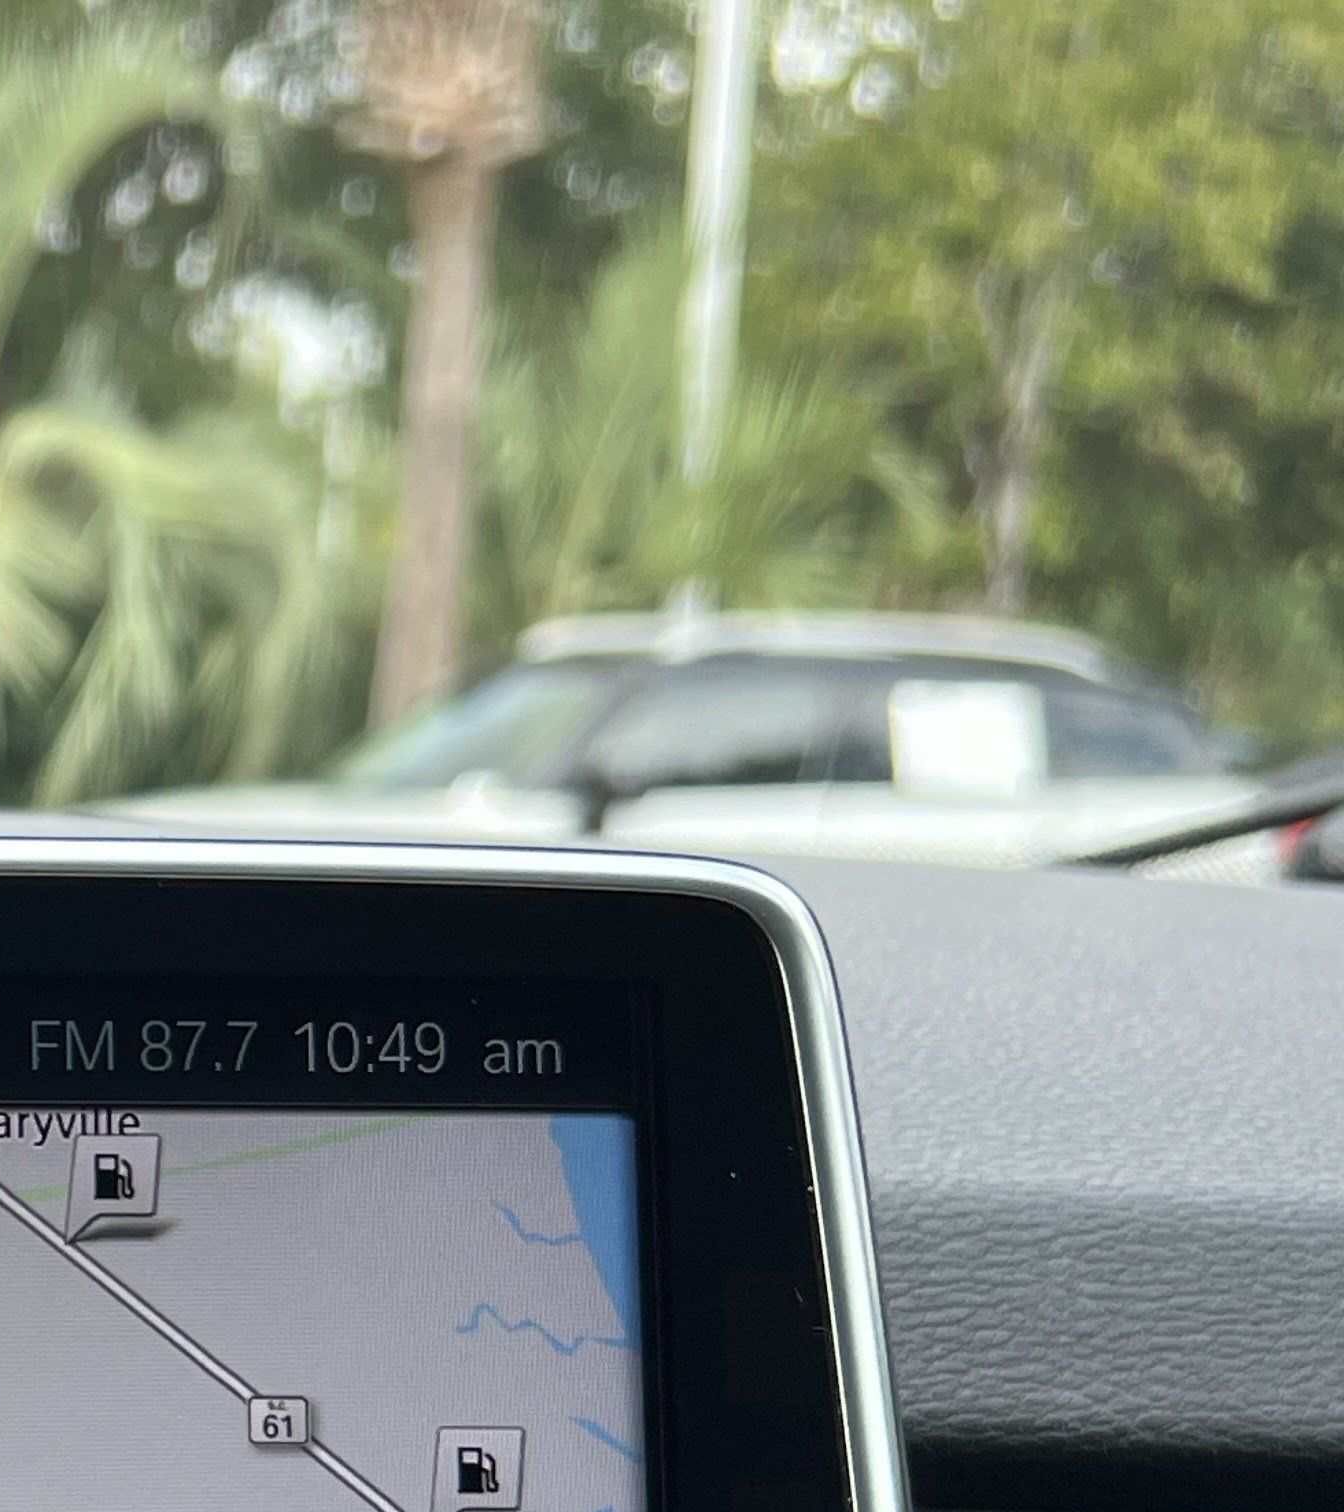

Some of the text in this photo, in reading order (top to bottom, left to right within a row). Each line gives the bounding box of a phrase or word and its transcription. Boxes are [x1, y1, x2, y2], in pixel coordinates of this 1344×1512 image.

[30, 1019, 259, 1073] FM 87.7
[292, 1021, 564, 1075] 10:49 am
[263, 1413, 293, 1439] 61
